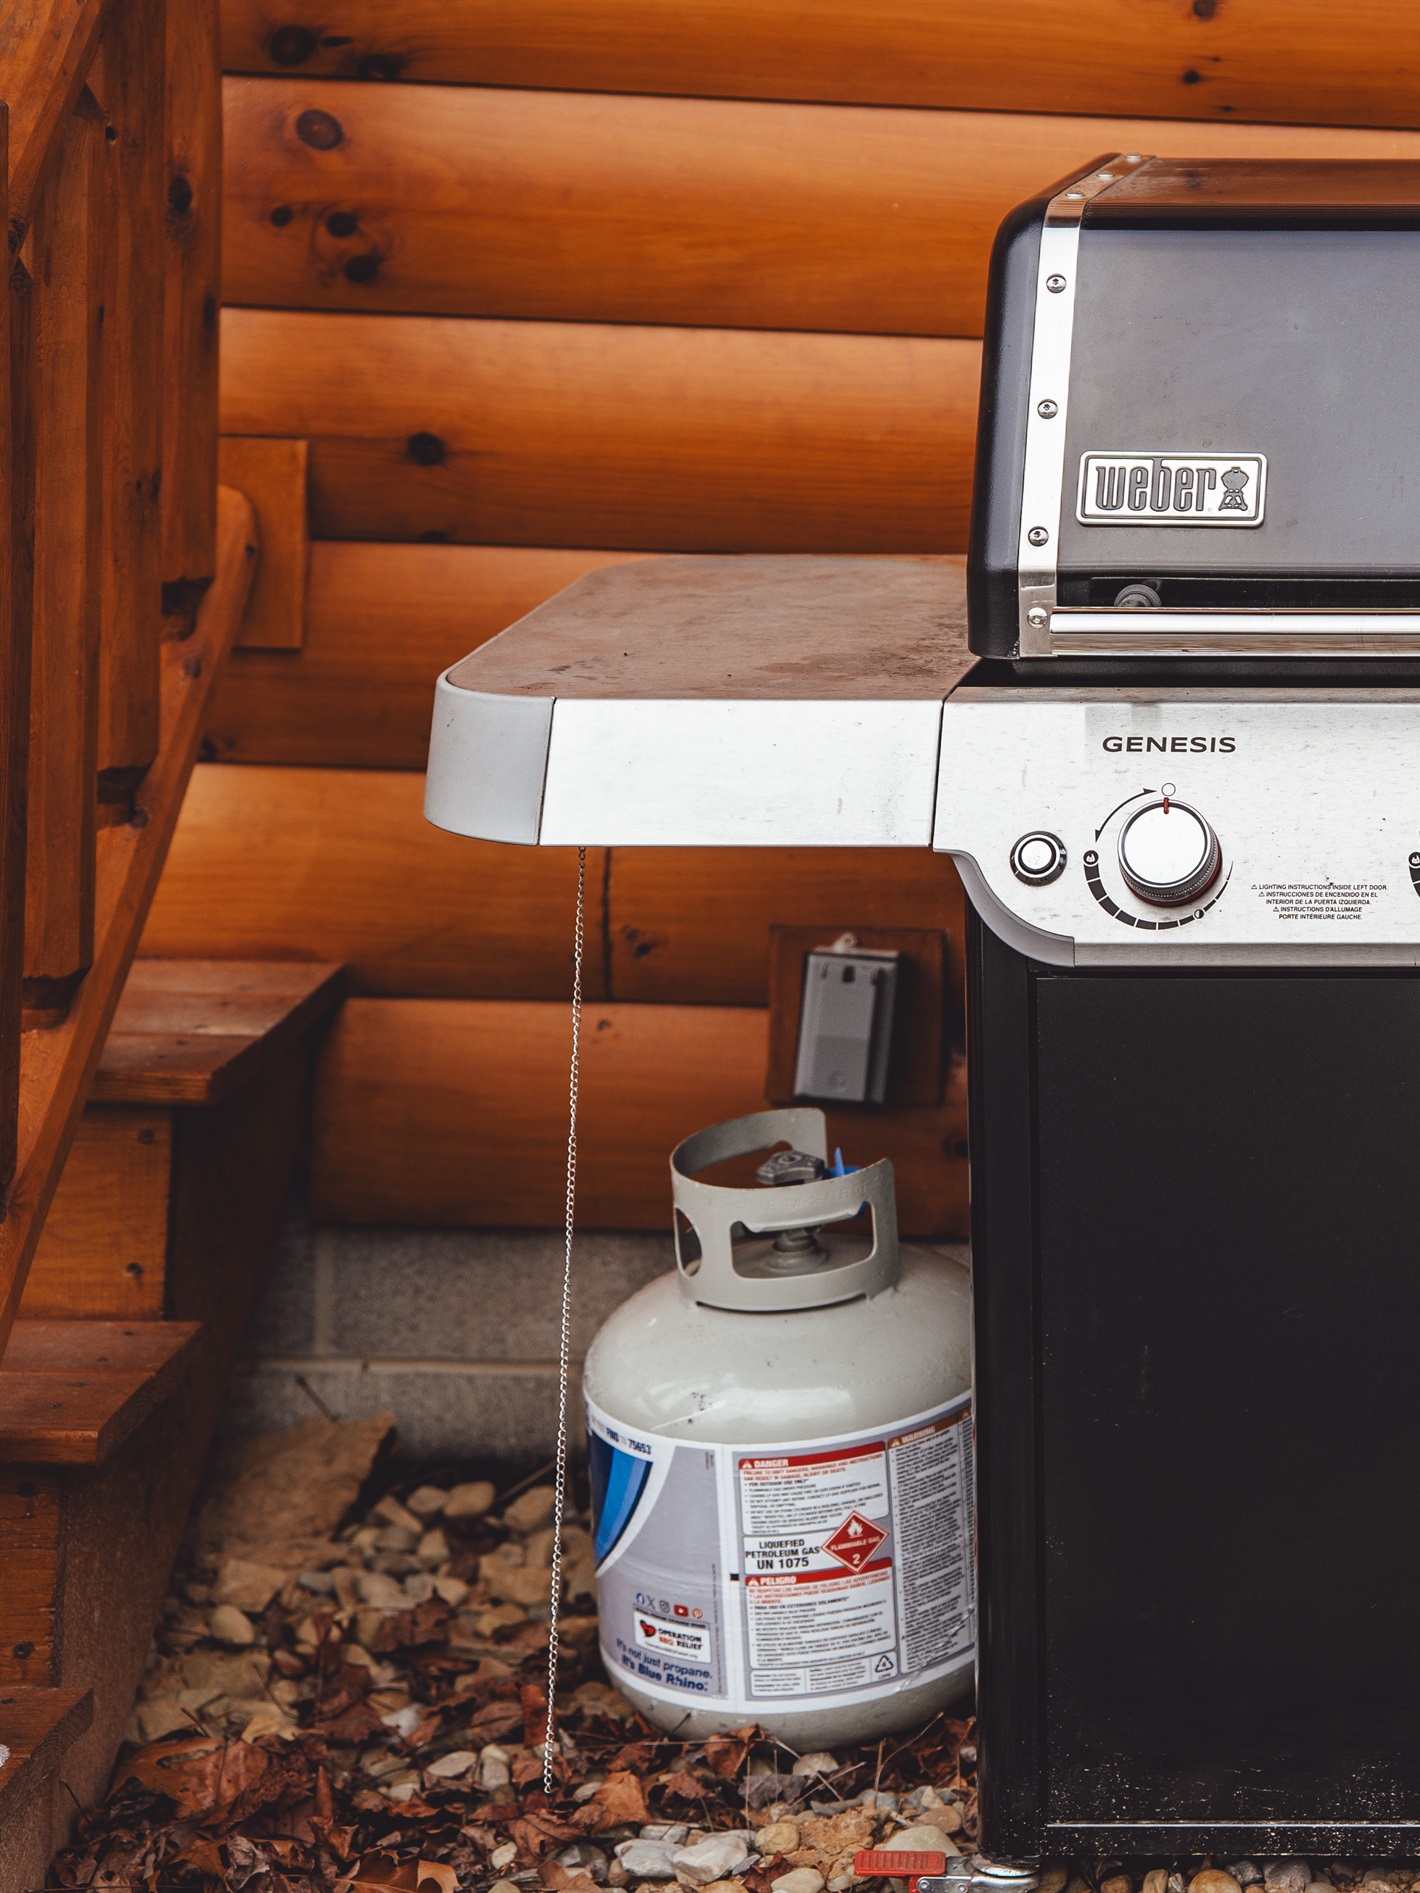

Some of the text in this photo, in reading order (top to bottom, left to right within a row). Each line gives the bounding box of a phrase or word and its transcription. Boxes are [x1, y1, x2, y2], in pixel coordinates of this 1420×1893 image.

[1096, 457, 1217, 512] weber
[1102, 736, 1237, 753] GENESIS
[754, 1459, 789, 1468] DANGER
[759, 1539, 805, 1549] LIQUEFIED
[831, 1536, 880, 1551] FLAMMABLE GAS
[745, 1546, 820, 1558] PETROLEUM GAS
[757, 1557, 809, 1569] UN 1075
[852, 1554, 860, 1564] 2
[760, 1575, 797, 1585] PELIGRO
[658, 1628, 702, 1642] OPERATION
[677, 1641, 703, 1650] RELIEF
[628, 1648, 641, 1660] not
[644, 1653, 660, 1667] just
[663, 1662, 712, 1679] propane.
[638, 1663, 662, 1681] Blue
